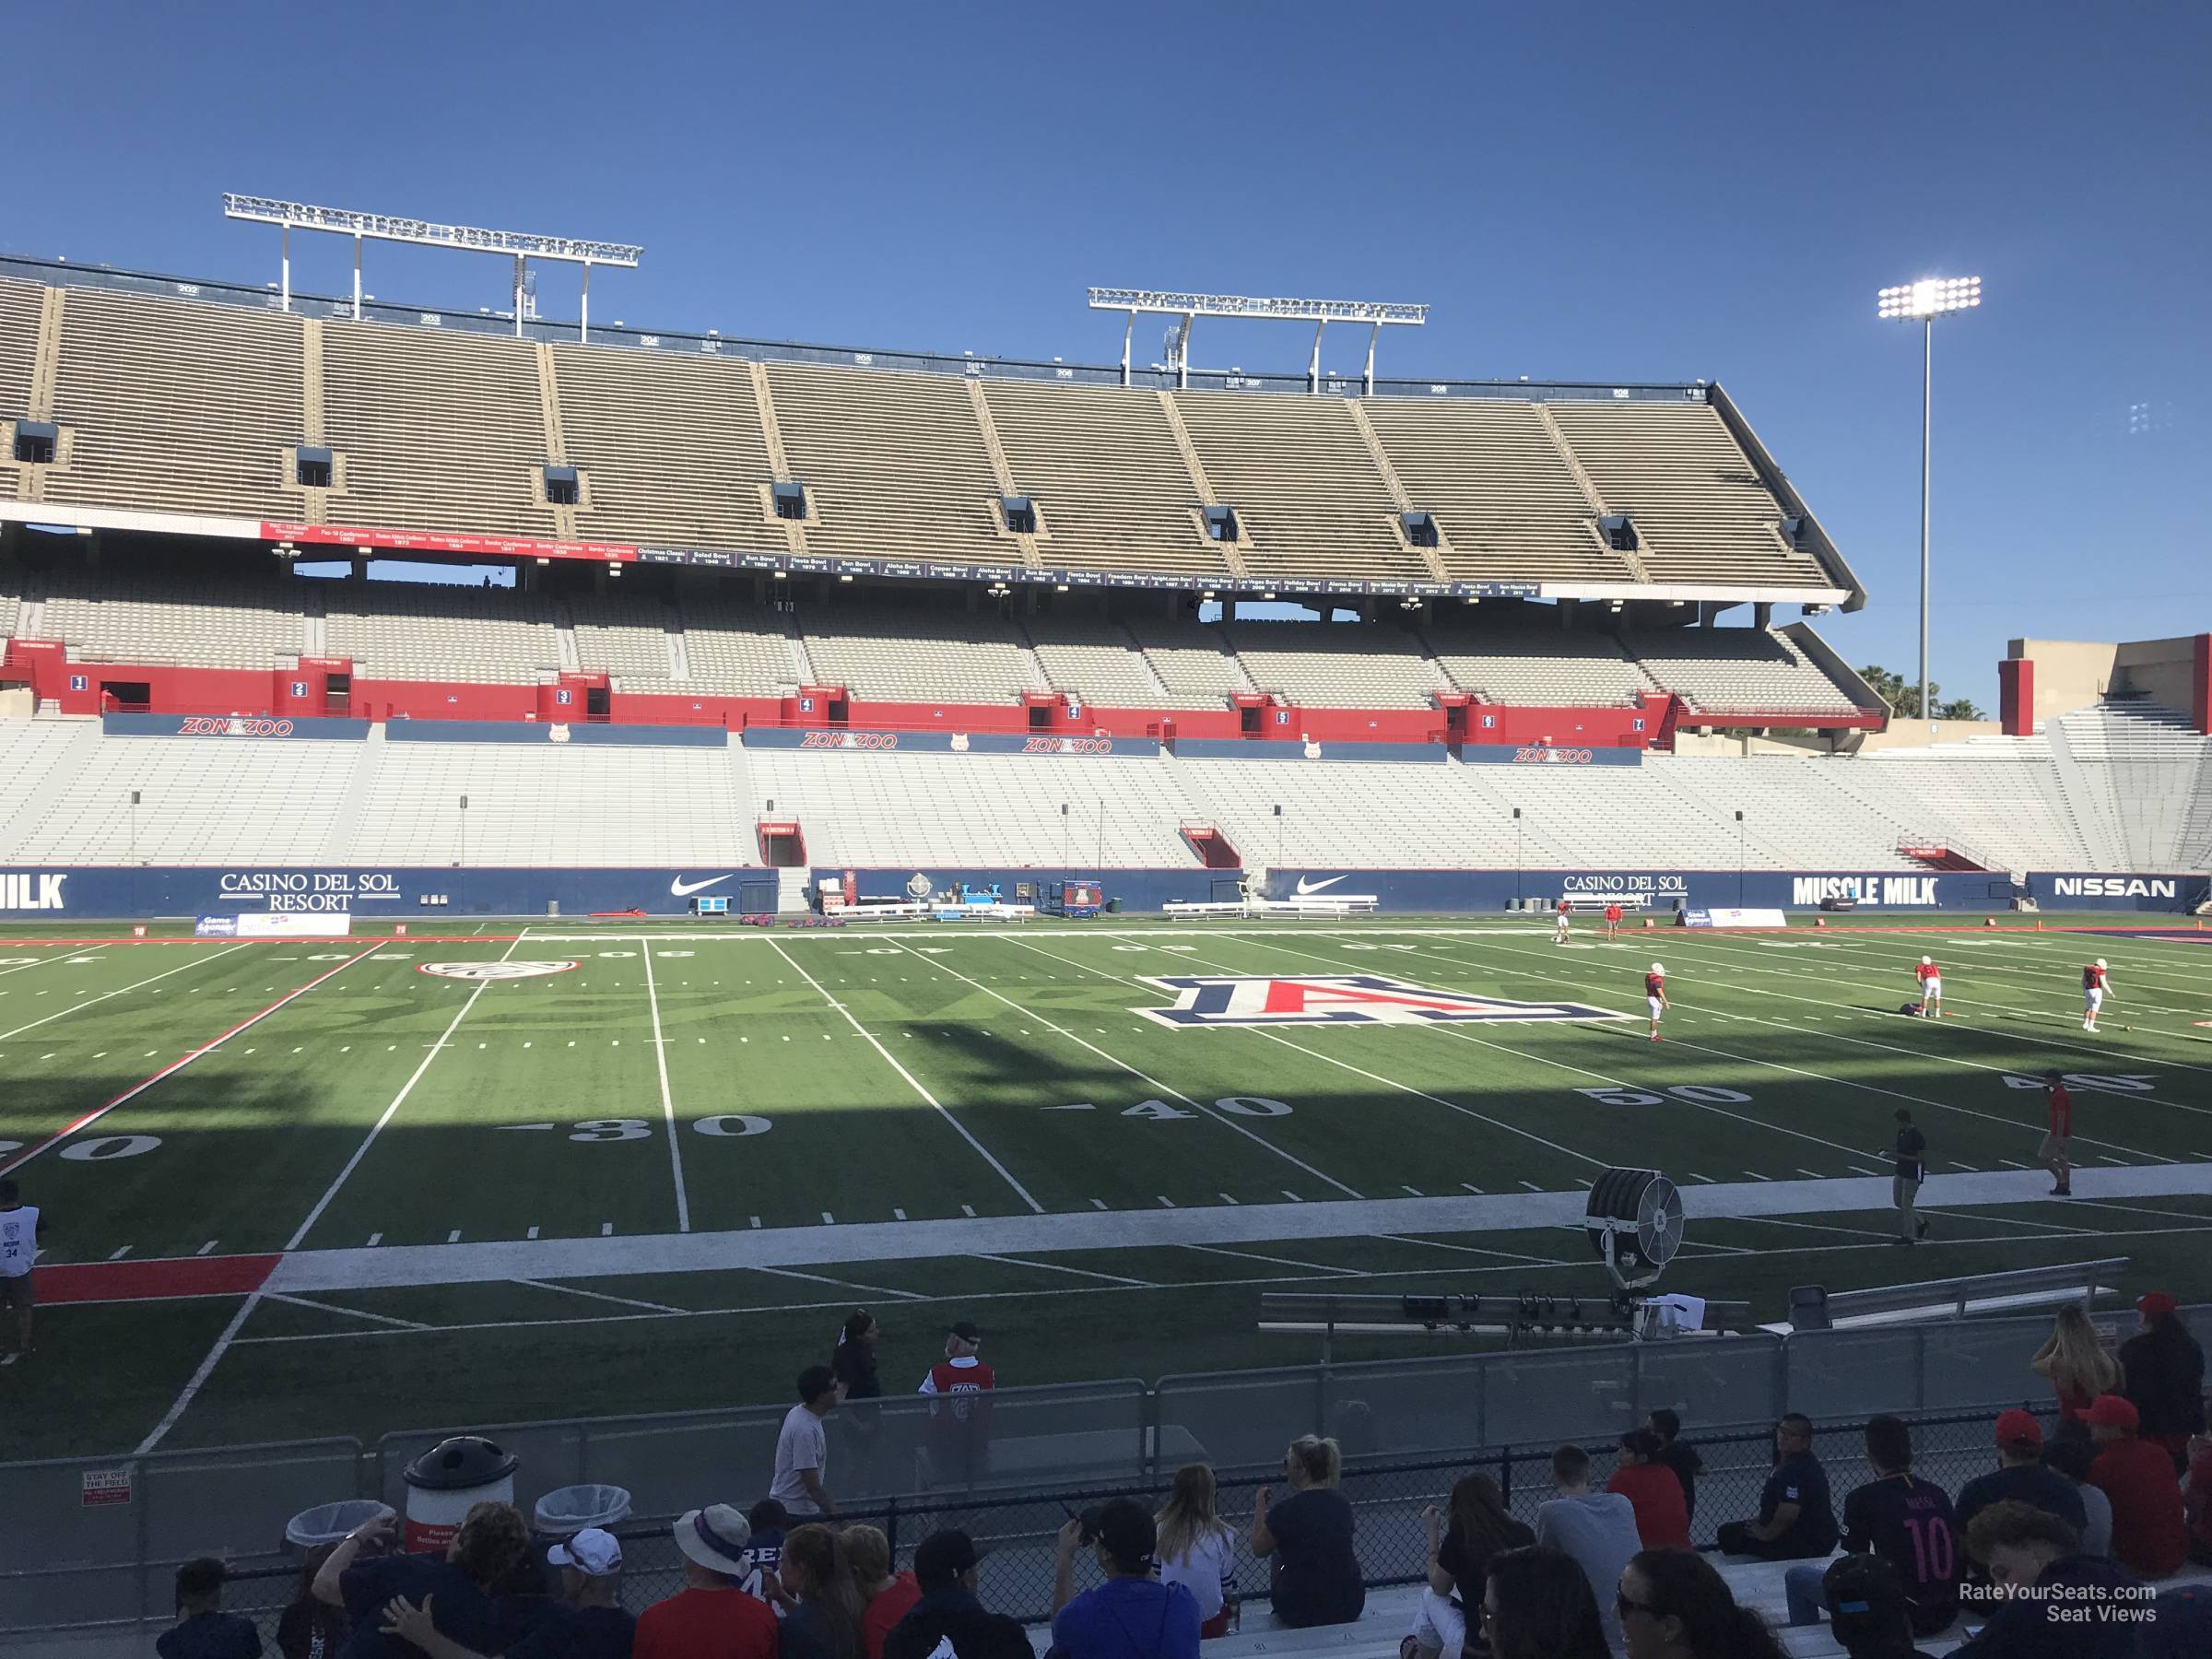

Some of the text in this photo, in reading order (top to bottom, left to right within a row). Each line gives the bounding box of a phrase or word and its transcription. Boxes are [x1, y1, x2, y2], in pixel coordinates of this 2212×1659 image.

[179, 285, 198, 293] 202
[422, 314, 441, 323] 203
[76, 677, 82, 686] 1
[296, 684, 303, 692] 2
[560, 691, 568, 700] 3
[1071, 707, 1077, 715] 4
[220, 874, 399, 891] CASINO DEL SOL
[1564, 876, 1688, 890] CASINO DEL SOL
[0, 874, 65, 909] ILK
[1793, 877, 1936, 905] MUSCLE MILK
[2054, 877, 2175, 898] NISSAN
[269, 894, 353, 912] RESORT
[204, 916, 230, 924] Game
[135, 927, 145, 935] 10
[198, 922, 236, 933] Sponsor
[6, 1249, 17, 1258] 34
[417, 1536, 440, 1545] Bottles
[1902, 1516, 1953, 1583] 10
